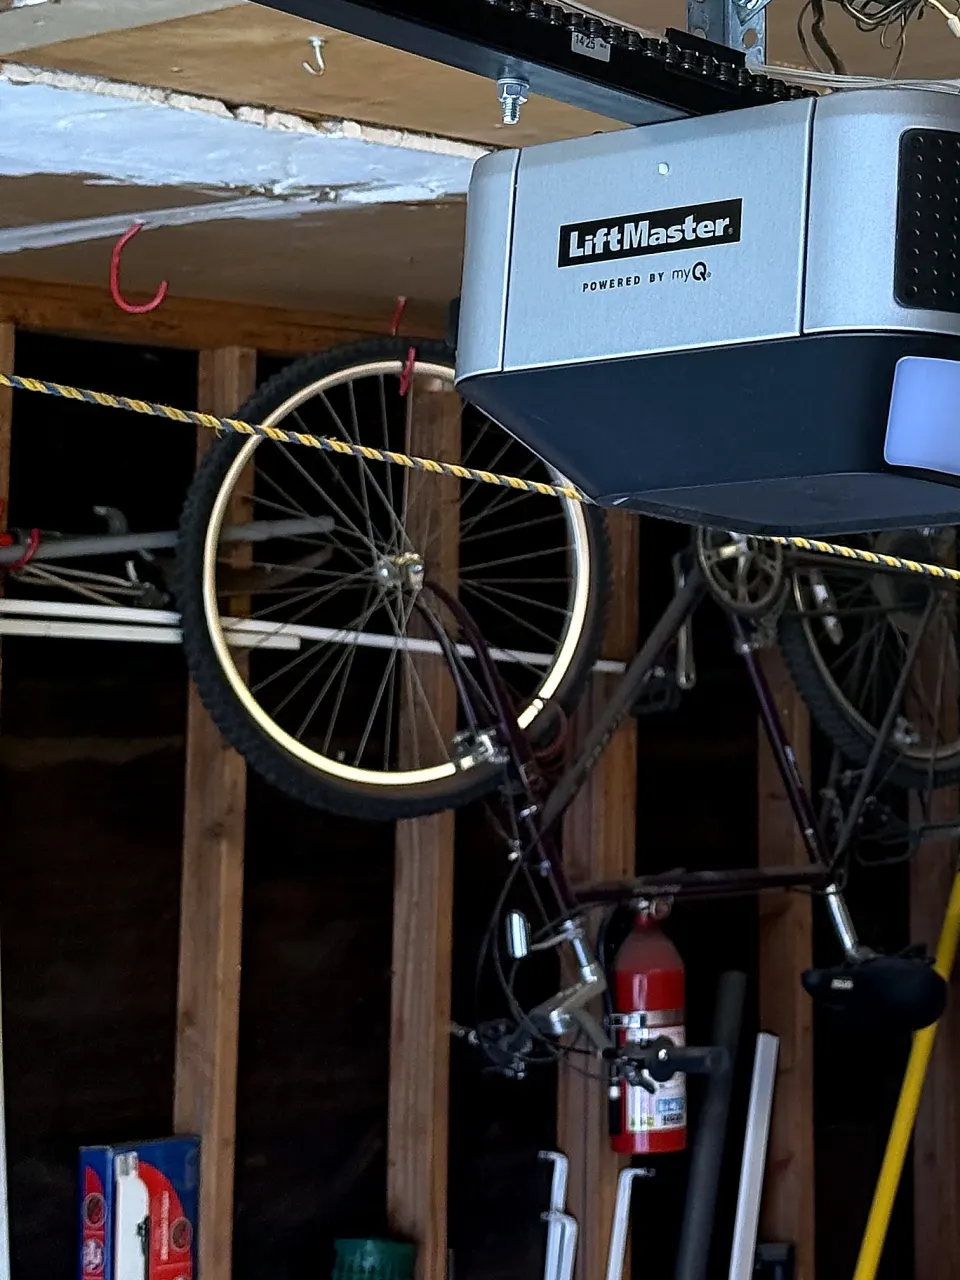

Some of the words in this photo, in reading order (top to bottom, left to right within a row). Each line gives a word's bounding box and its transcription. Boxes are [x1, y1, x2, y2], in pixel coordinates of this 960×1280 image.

[568, 213, 730, 258] LiftMaster
[582, 275, 641, 292] POWERED
[649, 272, 664, 283] BY
